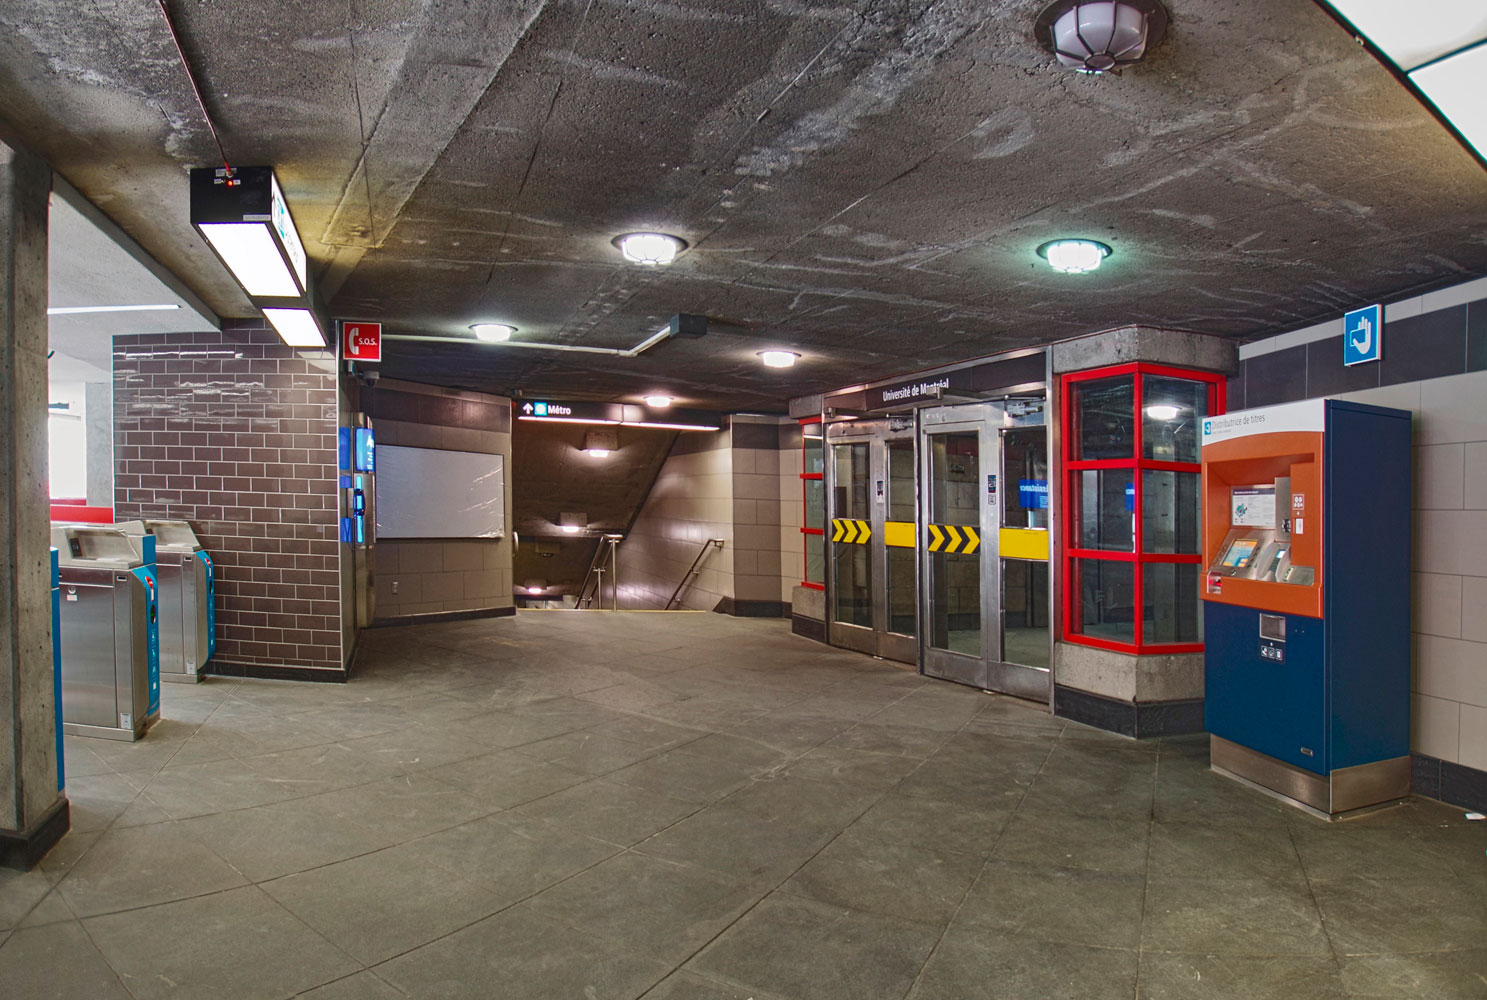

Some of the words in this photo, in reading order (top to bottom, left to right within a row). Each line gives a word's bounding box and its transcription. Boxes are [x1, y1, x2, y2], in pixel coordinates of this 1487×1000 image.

[358, 337, 378, 346] S.O.S.
[882, 385, 911, 402] Université
[912, 384, 920, 396] de
[547, 404, 572, 415] Métro
[1243, 415, 1250, 425] de
[1250, 414, 1266, 424] titres
